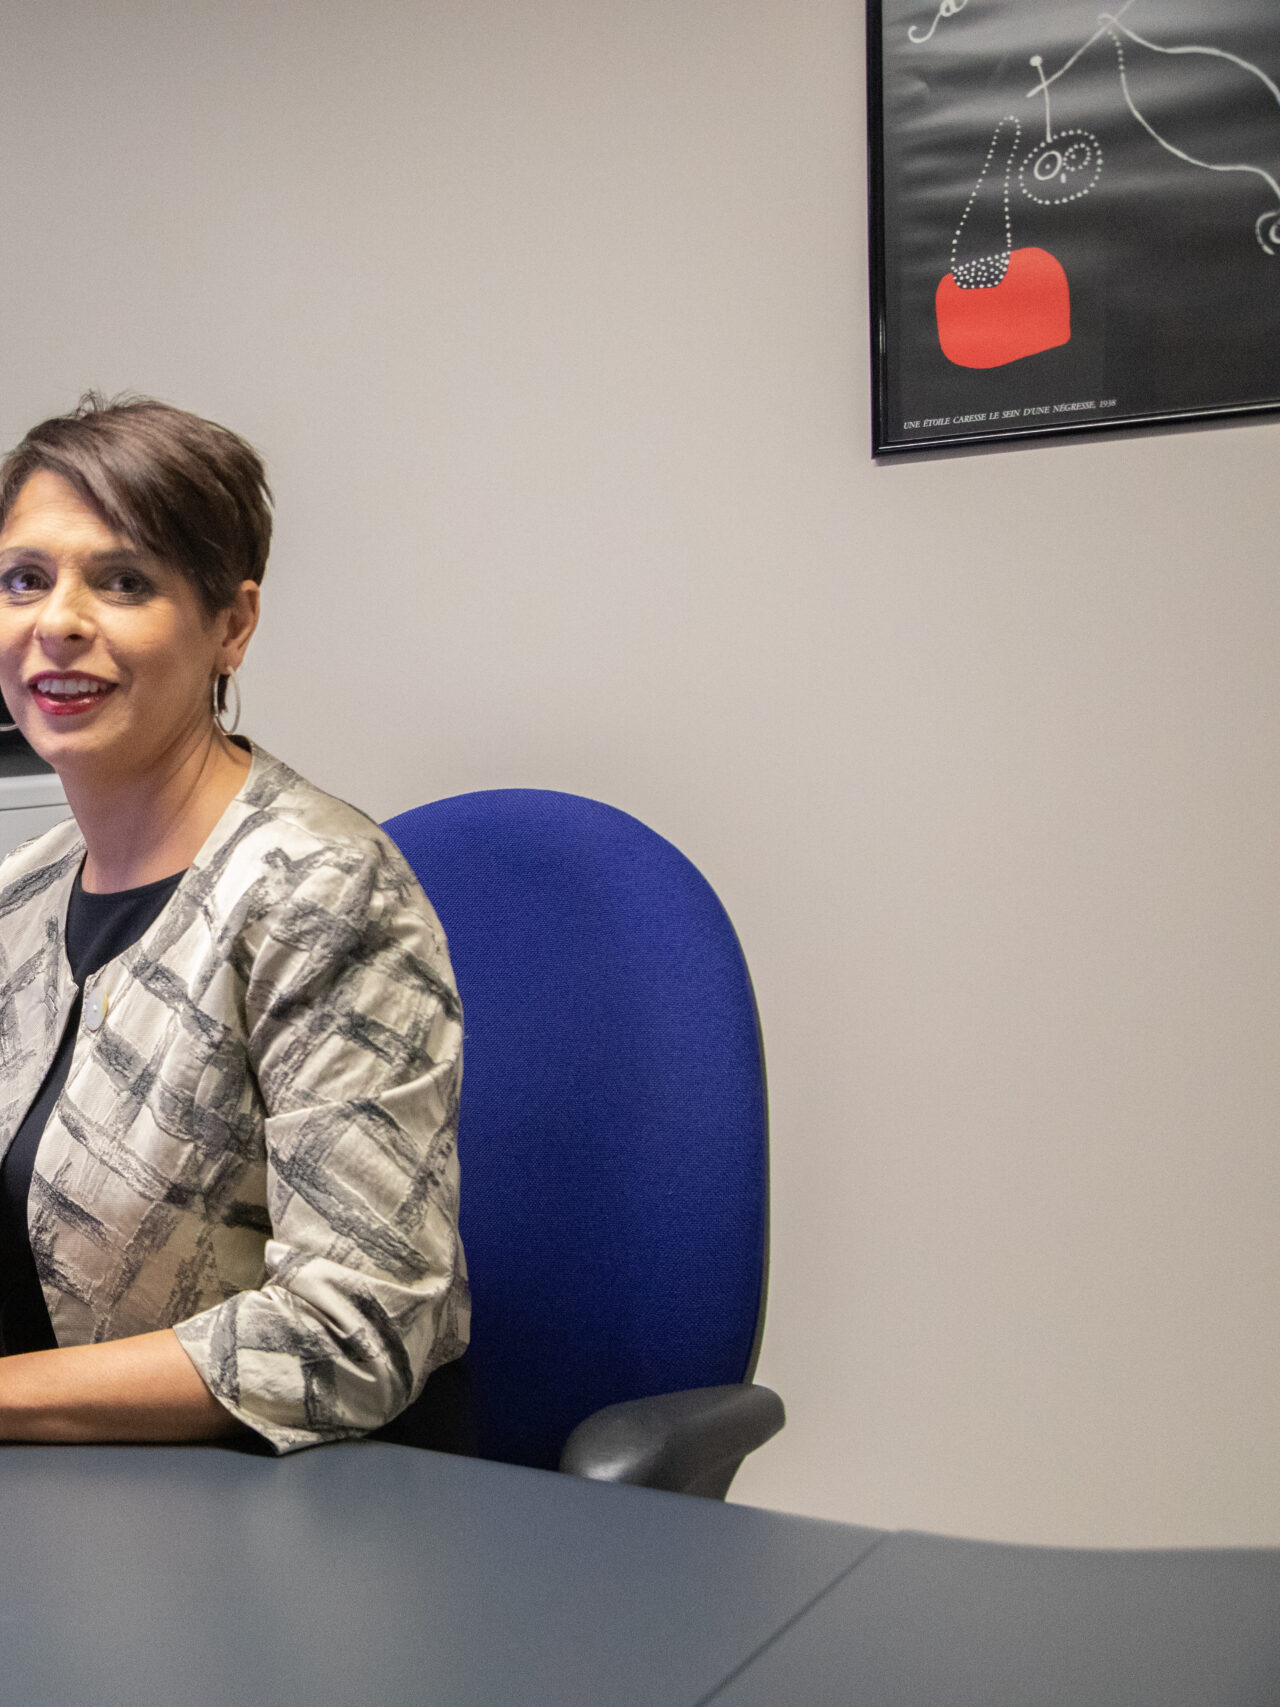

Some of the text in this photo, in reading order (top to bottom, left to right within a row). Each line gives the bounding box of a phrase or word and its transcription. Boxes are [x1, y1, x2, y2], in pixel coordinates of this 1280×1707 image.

[903, 420, 920, 430] UNE
[923, 416, 950, 427] ÉTOILE
[953, 413, 986, 424] CARESSE
[989, 412, 999, 420] LE
[1002, 408, 1021, 419] SEIN
[1023, 405, 1050, 416] D'UNE
[1099, 399, 1117, 409] 1938
